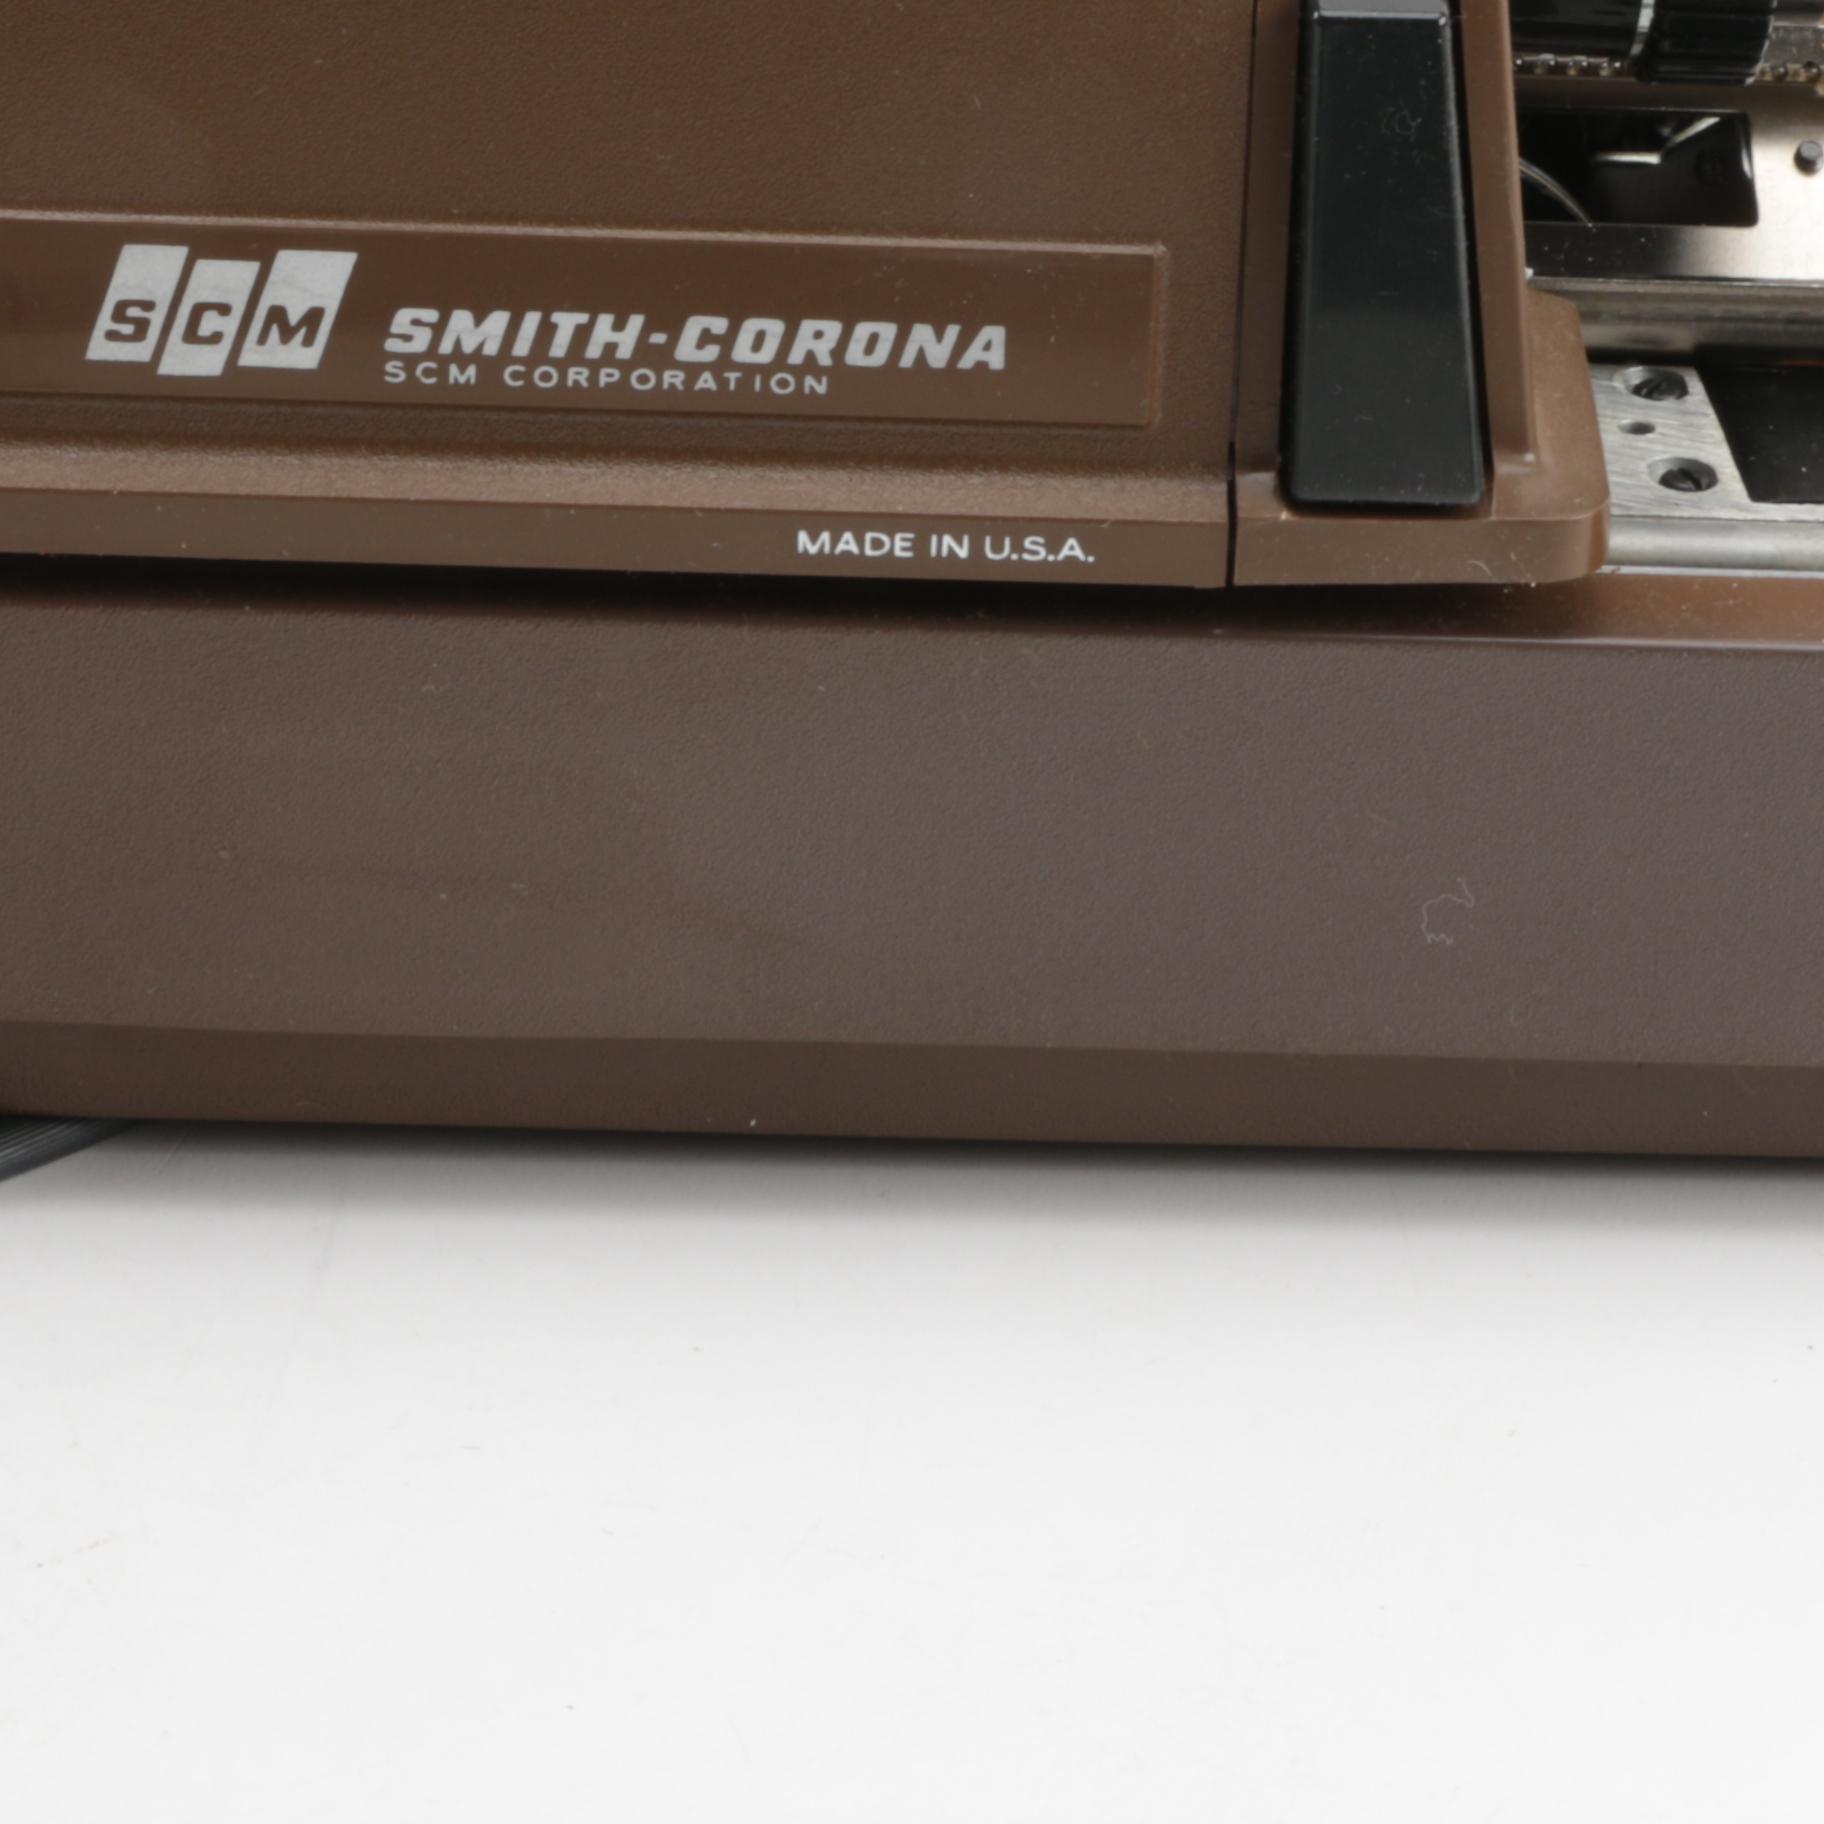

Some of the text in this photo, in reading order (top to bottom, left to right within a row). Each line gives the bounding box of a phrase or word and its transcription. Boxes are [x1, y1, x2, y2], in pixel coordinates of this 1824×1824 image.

[384, 307, 1006, 370] SMITH-CORONA
[384, 361, 828, 395] SCM CORPORATION
[797, 530, 1095, 562] MADE IN U.S.A.
